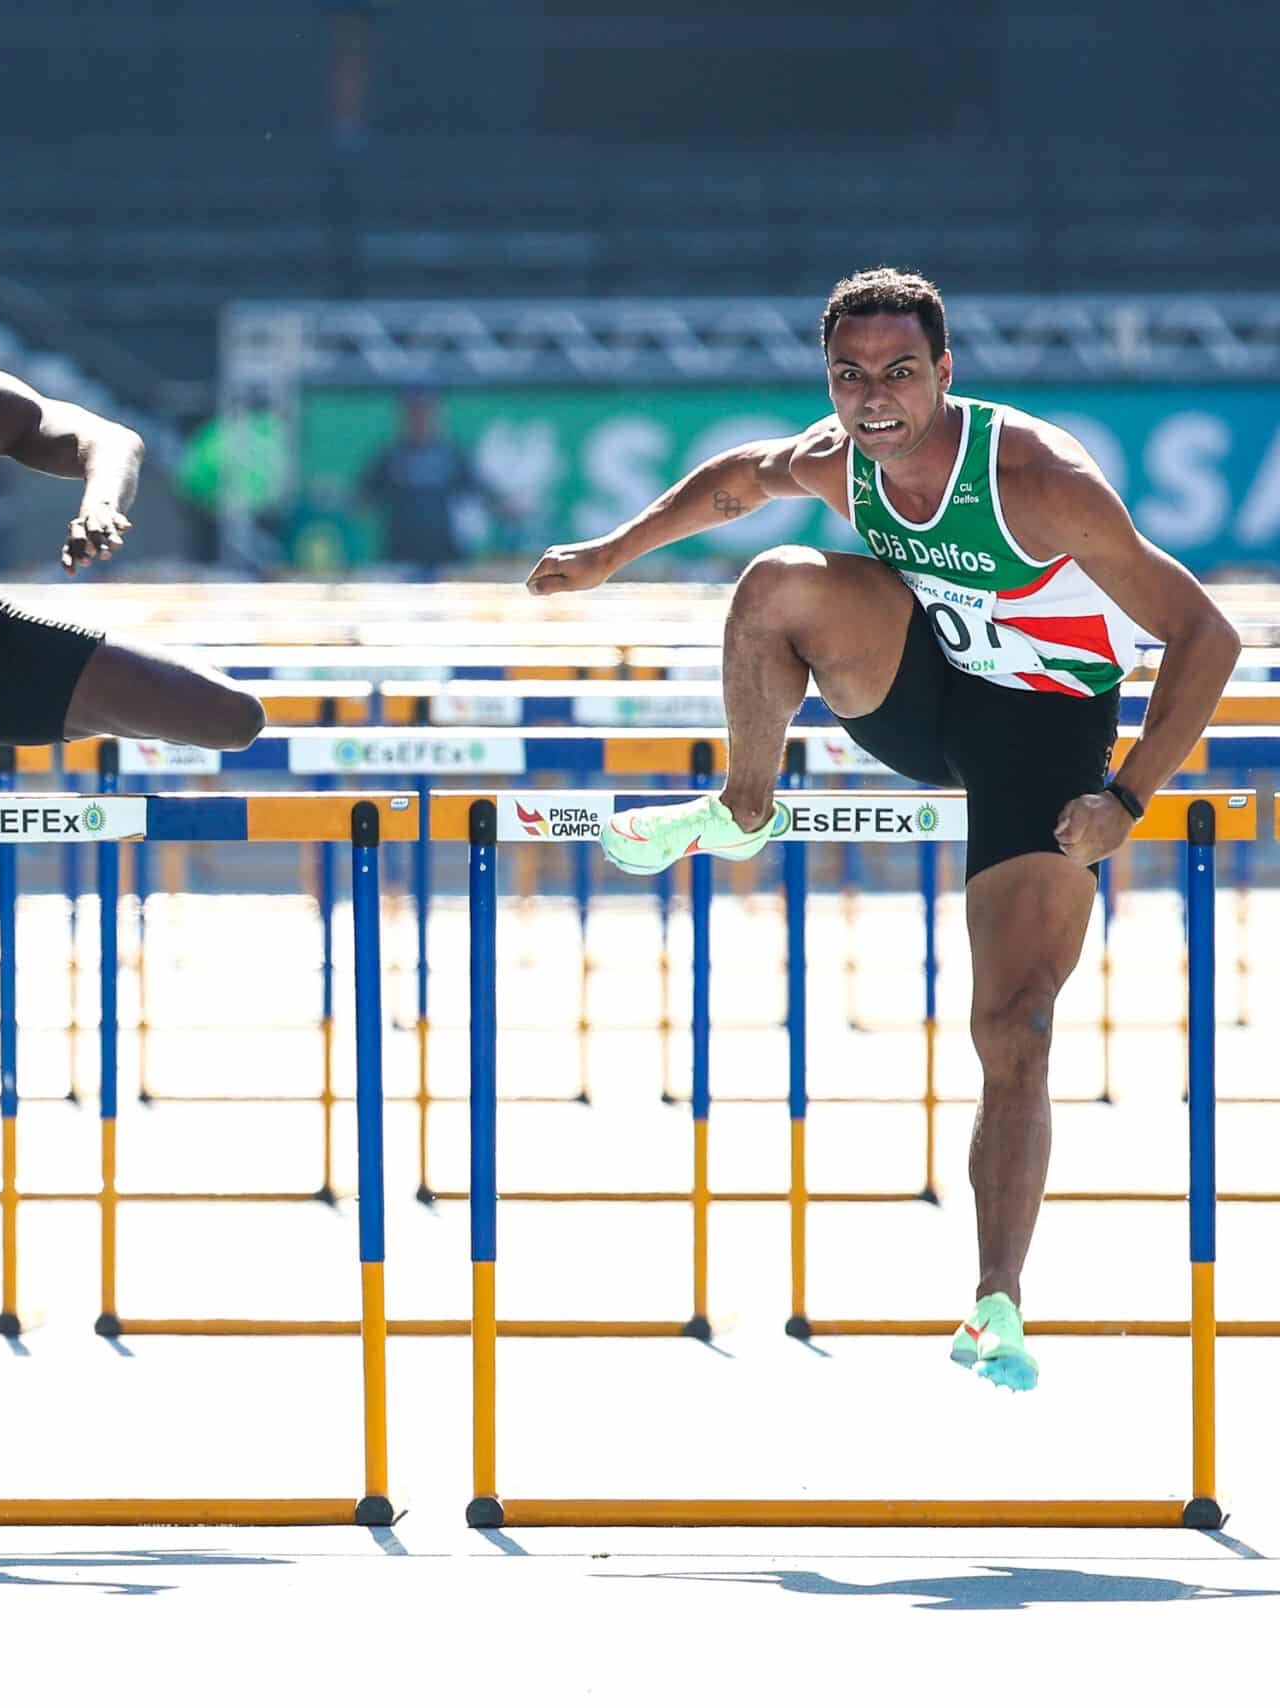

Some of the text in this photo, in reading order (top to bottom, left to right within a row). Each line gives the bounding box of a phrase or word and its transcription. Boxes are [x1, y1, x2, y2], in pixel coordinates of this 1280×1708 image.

[868, 528, 996, 572] Clã Delfos
[943, 590, 984, 609] CAIXA
[549, 808, 598, 822] PISTA e
[791, 807, 913, 833] EsEFEx
[551, 823, 601, 837] CAMPO
